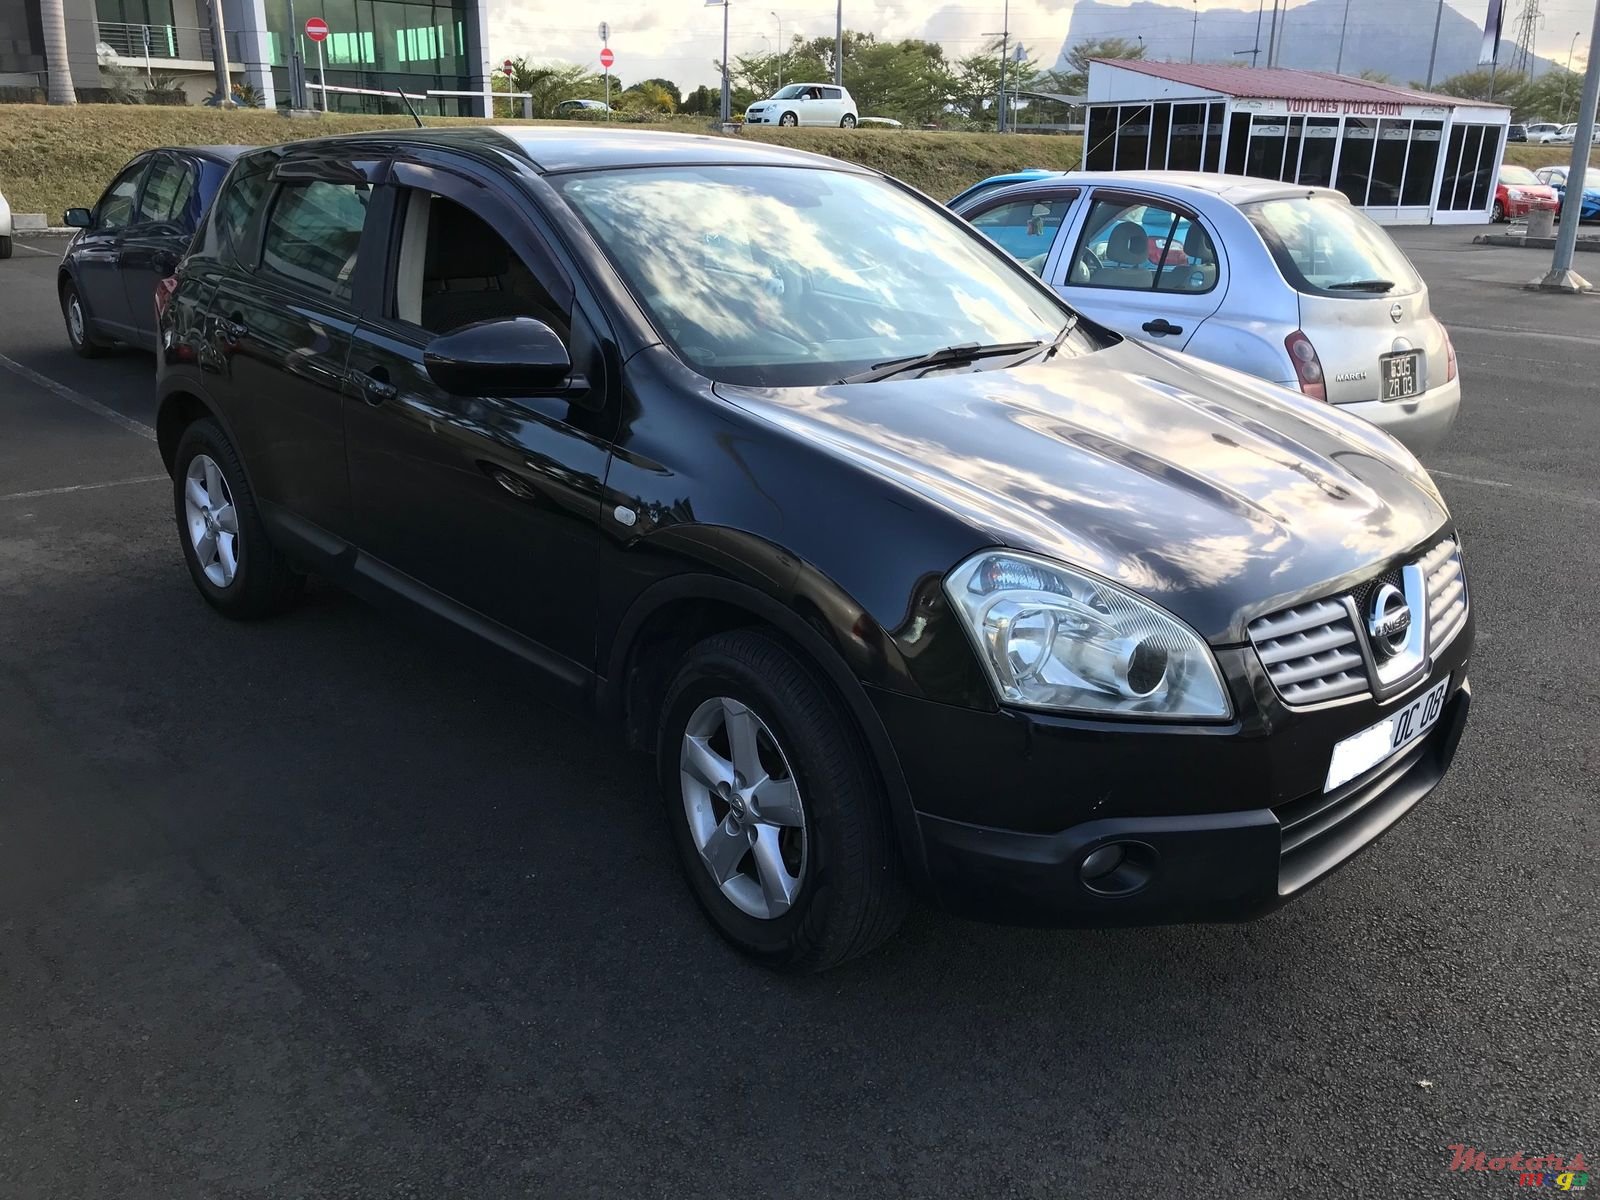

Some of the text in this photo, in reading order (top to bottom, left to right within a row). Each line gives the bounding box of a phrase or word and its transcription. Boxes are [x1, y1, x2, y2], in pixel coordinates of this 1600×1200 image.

[1286, 99, 1339, 113] VOITURES
[1343, 101, 1403, 116] D'OCCASION
[1335, 372, 1367, 382] MARCH
[1402, 376, 1413, 395] 03
[1420, 684, 1445, 729] 08
